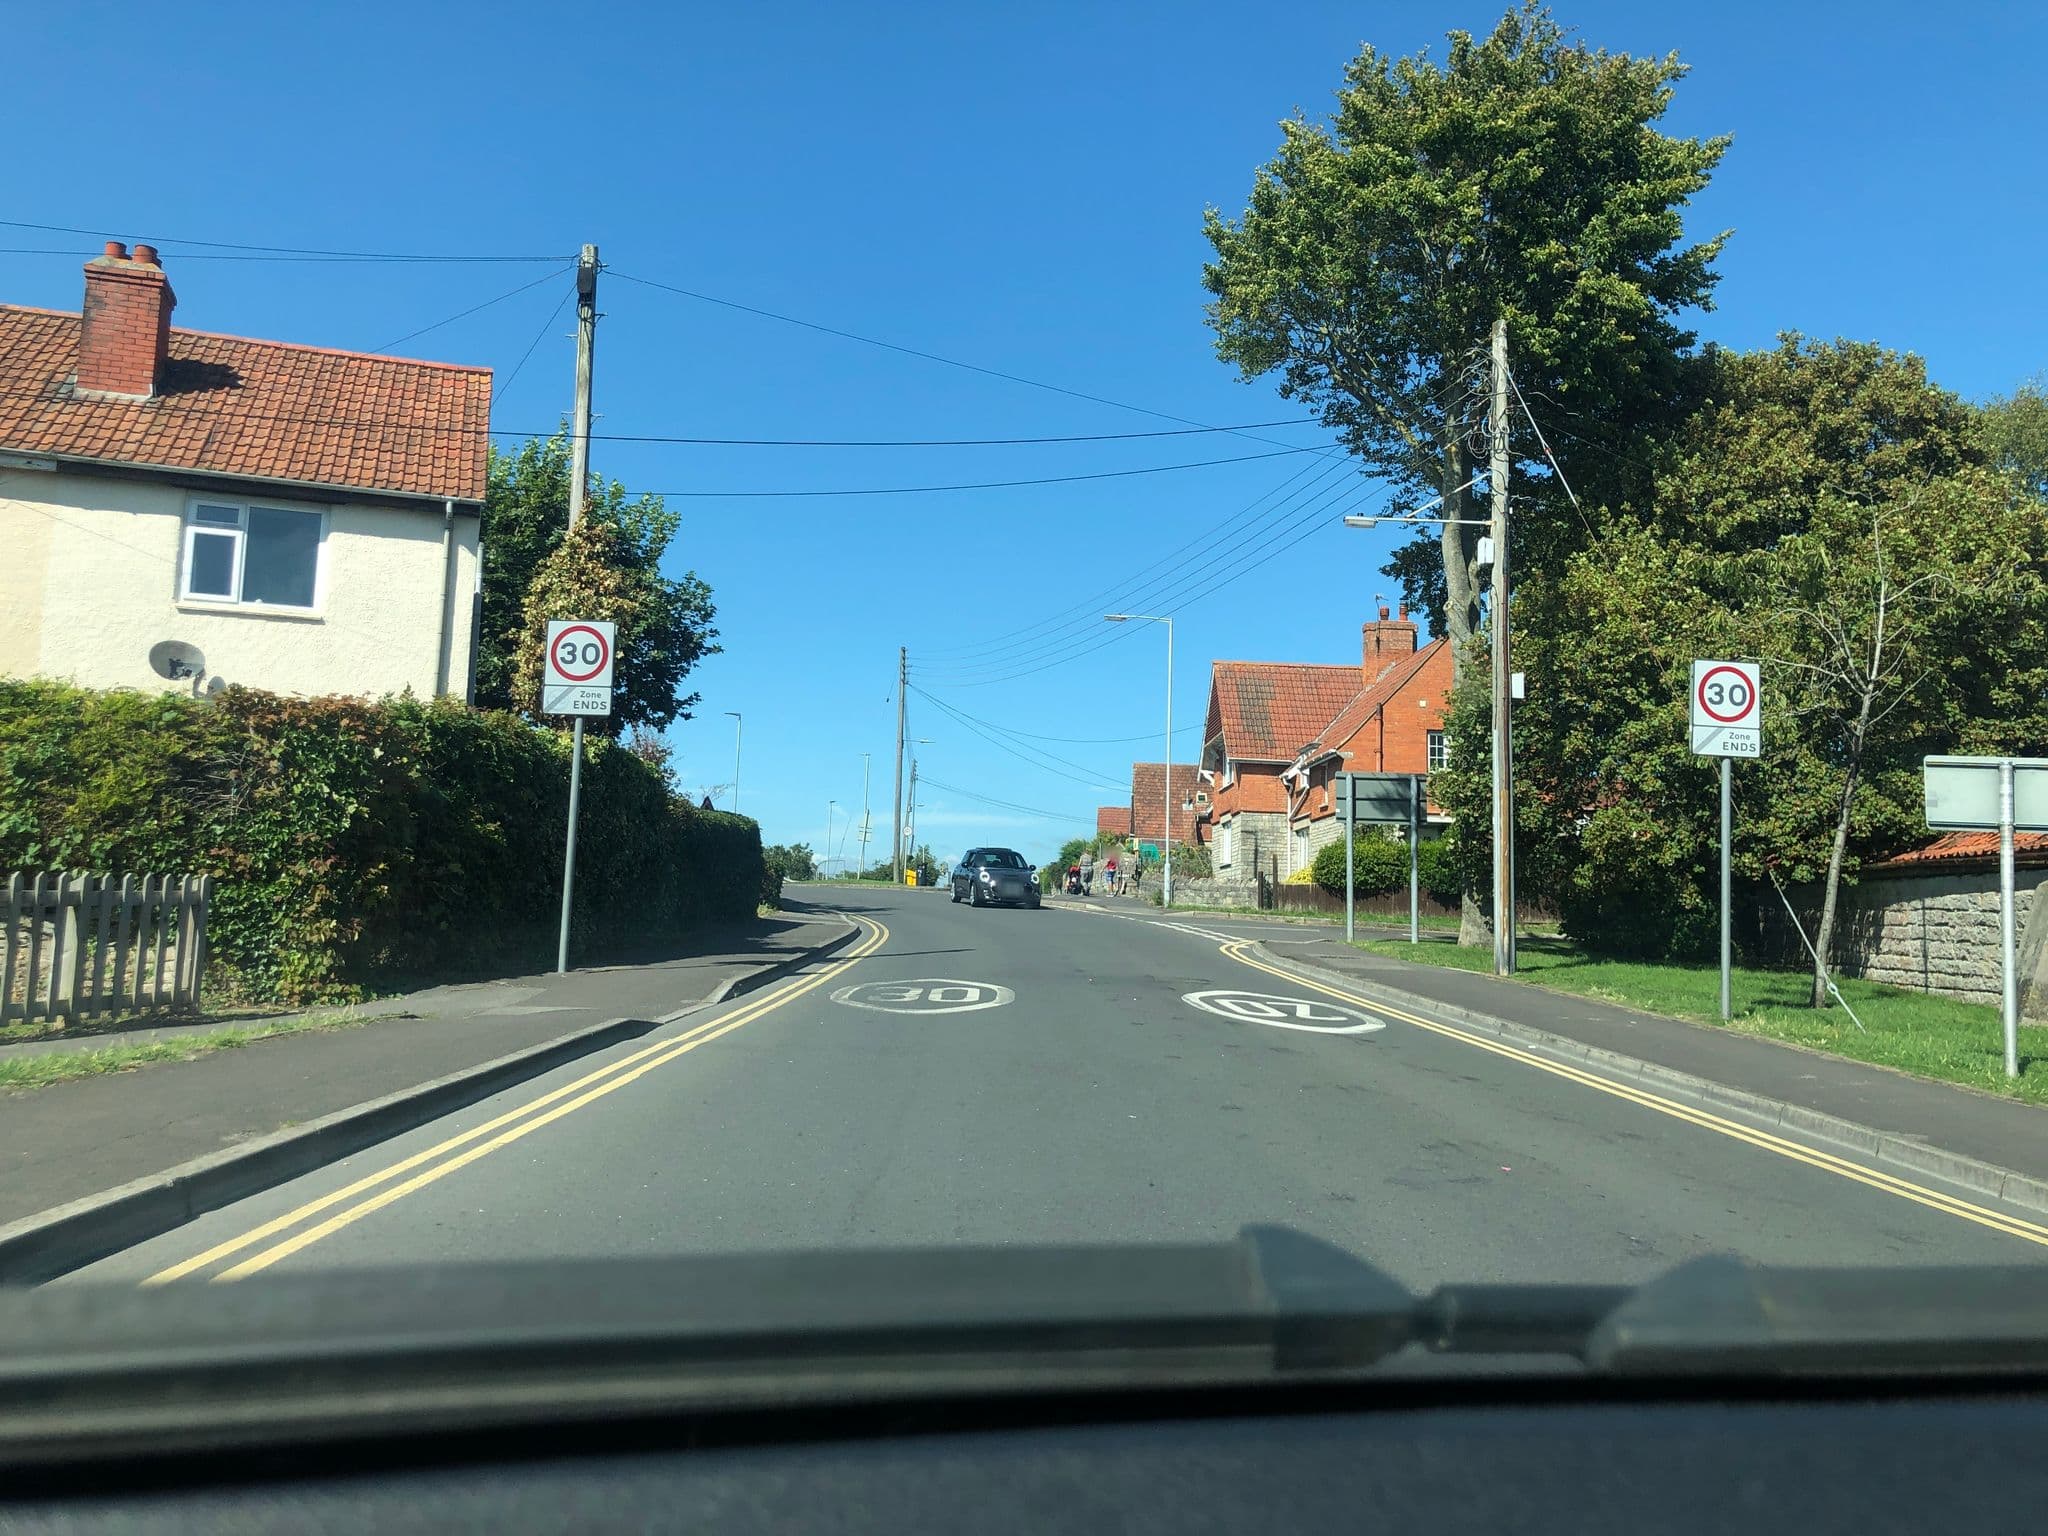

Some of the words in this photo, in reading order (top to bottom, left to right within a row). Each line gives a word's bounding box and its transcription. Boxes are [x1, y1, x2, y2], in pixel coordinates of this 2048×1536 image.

[560, 642, 600, 665] 30
[580, 690, 602, 699] Zone
[1708, 683, 1747, 706] 30
[573, 700, 607, 710] ENDS
[1729, 732, 1751, 741] Zone
[1722, 742, 1756, 752] ENDS
[867, 986, 980, 1002] 30
